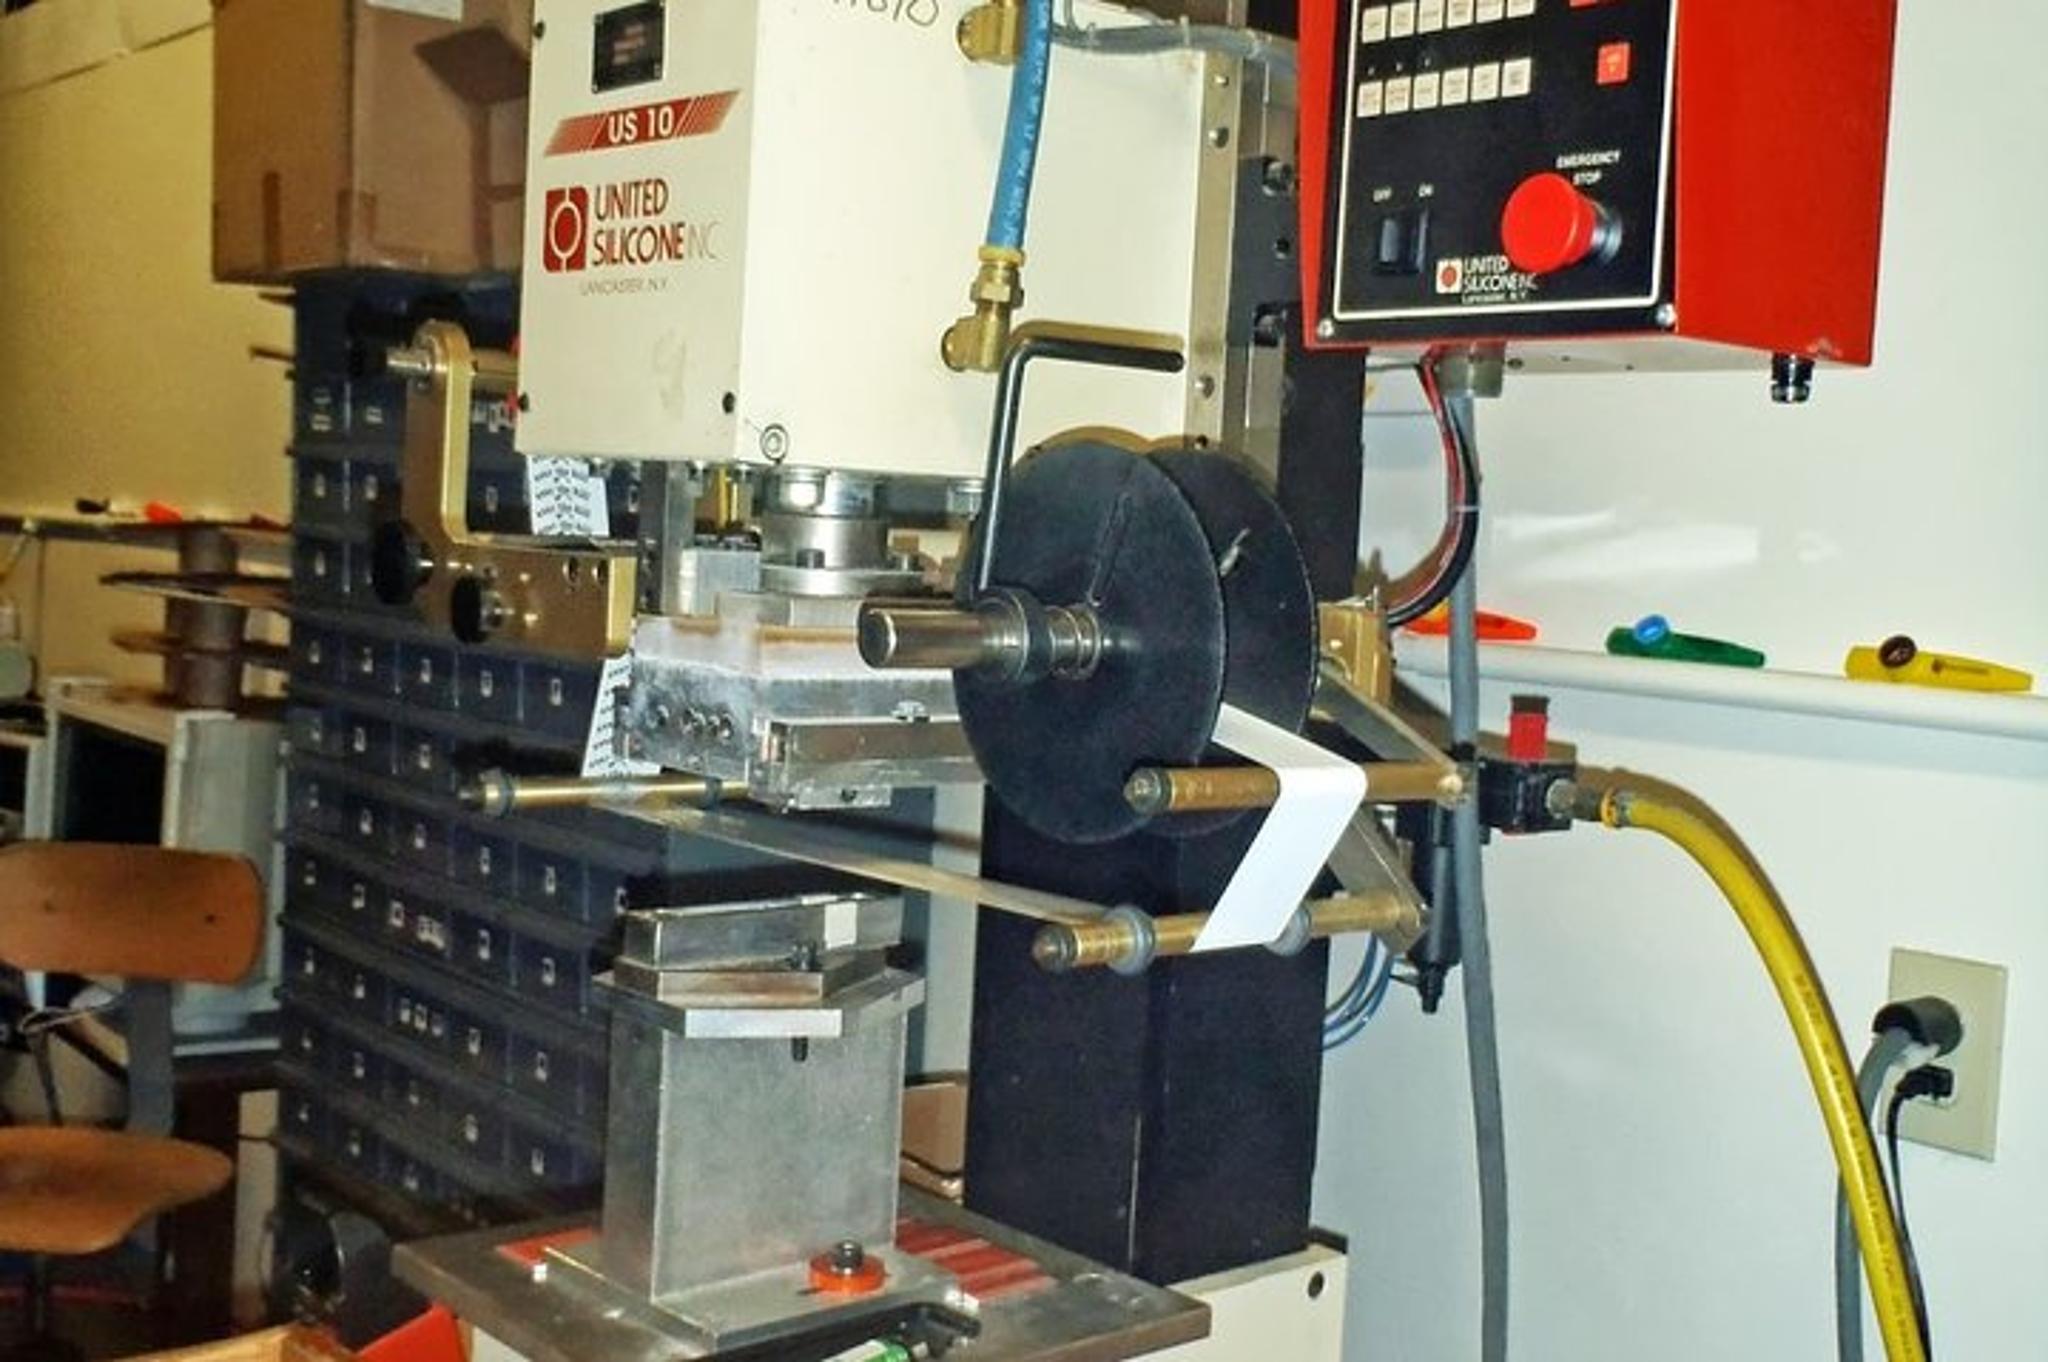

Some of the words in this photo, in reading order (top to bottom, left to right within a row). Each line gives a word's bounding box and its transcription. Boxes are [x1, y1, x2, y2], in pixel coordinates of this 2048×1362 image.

[608, 110, 638, 143] US
[647, 105, 674, 137] 10
[1555, 150, 1620, 168] EMERGENCY
[1573, 169, 1602, 185] STOP
[1418, 182, 1434, 197] ON
[593, 178, 669, 221] UNITED
[1464, 255, 1509, 274] UNITED
